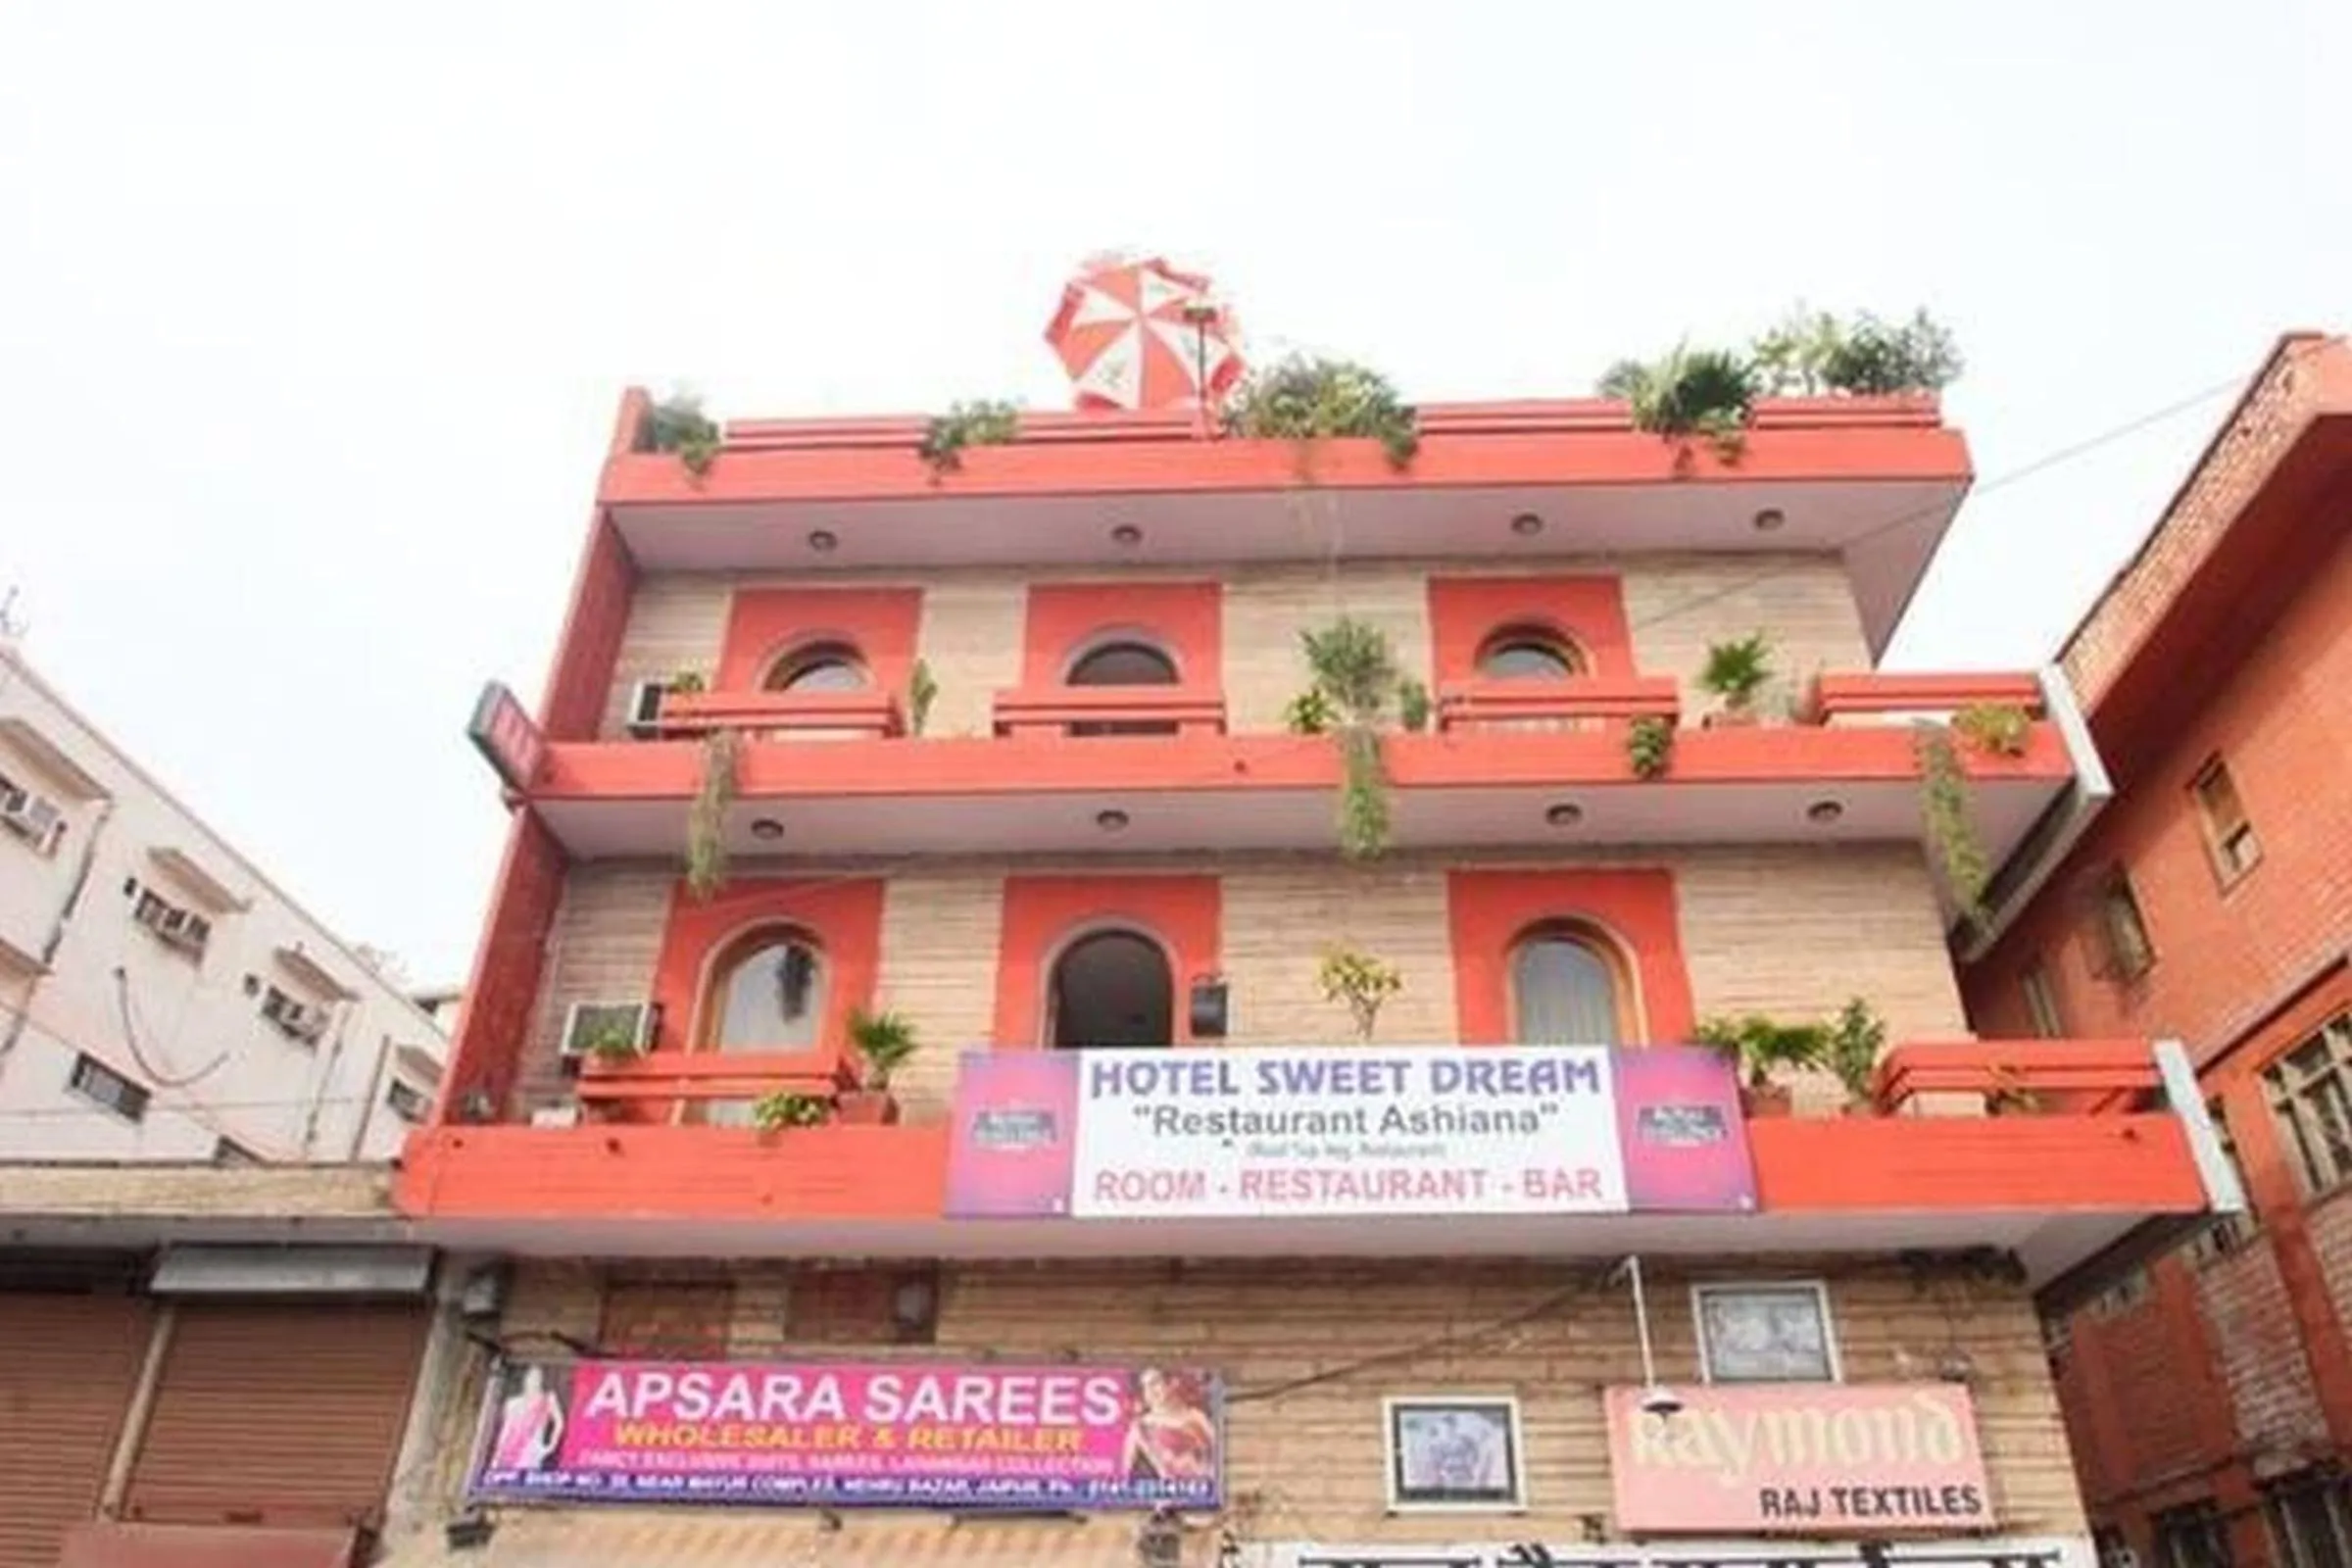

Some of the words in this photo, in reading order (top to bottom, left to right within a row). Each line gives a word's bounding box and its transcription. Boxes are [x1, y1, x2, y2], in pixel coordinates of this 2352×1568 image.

[1091, 1059, 1239, 1099] HOTEL
[1257, 1061, 1413, 1097] SWEET
[1430, 1061, 1600, 1096] DREAM
[1134, 1104, 1370, 1137] "Restaurant
[1095, 1170, 1206, 1201] ROOM
[1241, 1168, 1489, 1201] RESTAURANT
[1523, 1167, 1603, 1200] BAR
[584, 1373, 846, 1422] APSARA
[864, 1376, 1121, 1425] SAREES
[612, 1424, 859, 1450] WHOLESALER
[907, 1427, 1084, 1452] RETAILER
[1760, 1488, 1821, 1517] RAJ
[1831, 1486, 1982, 1516] TEXTILES
